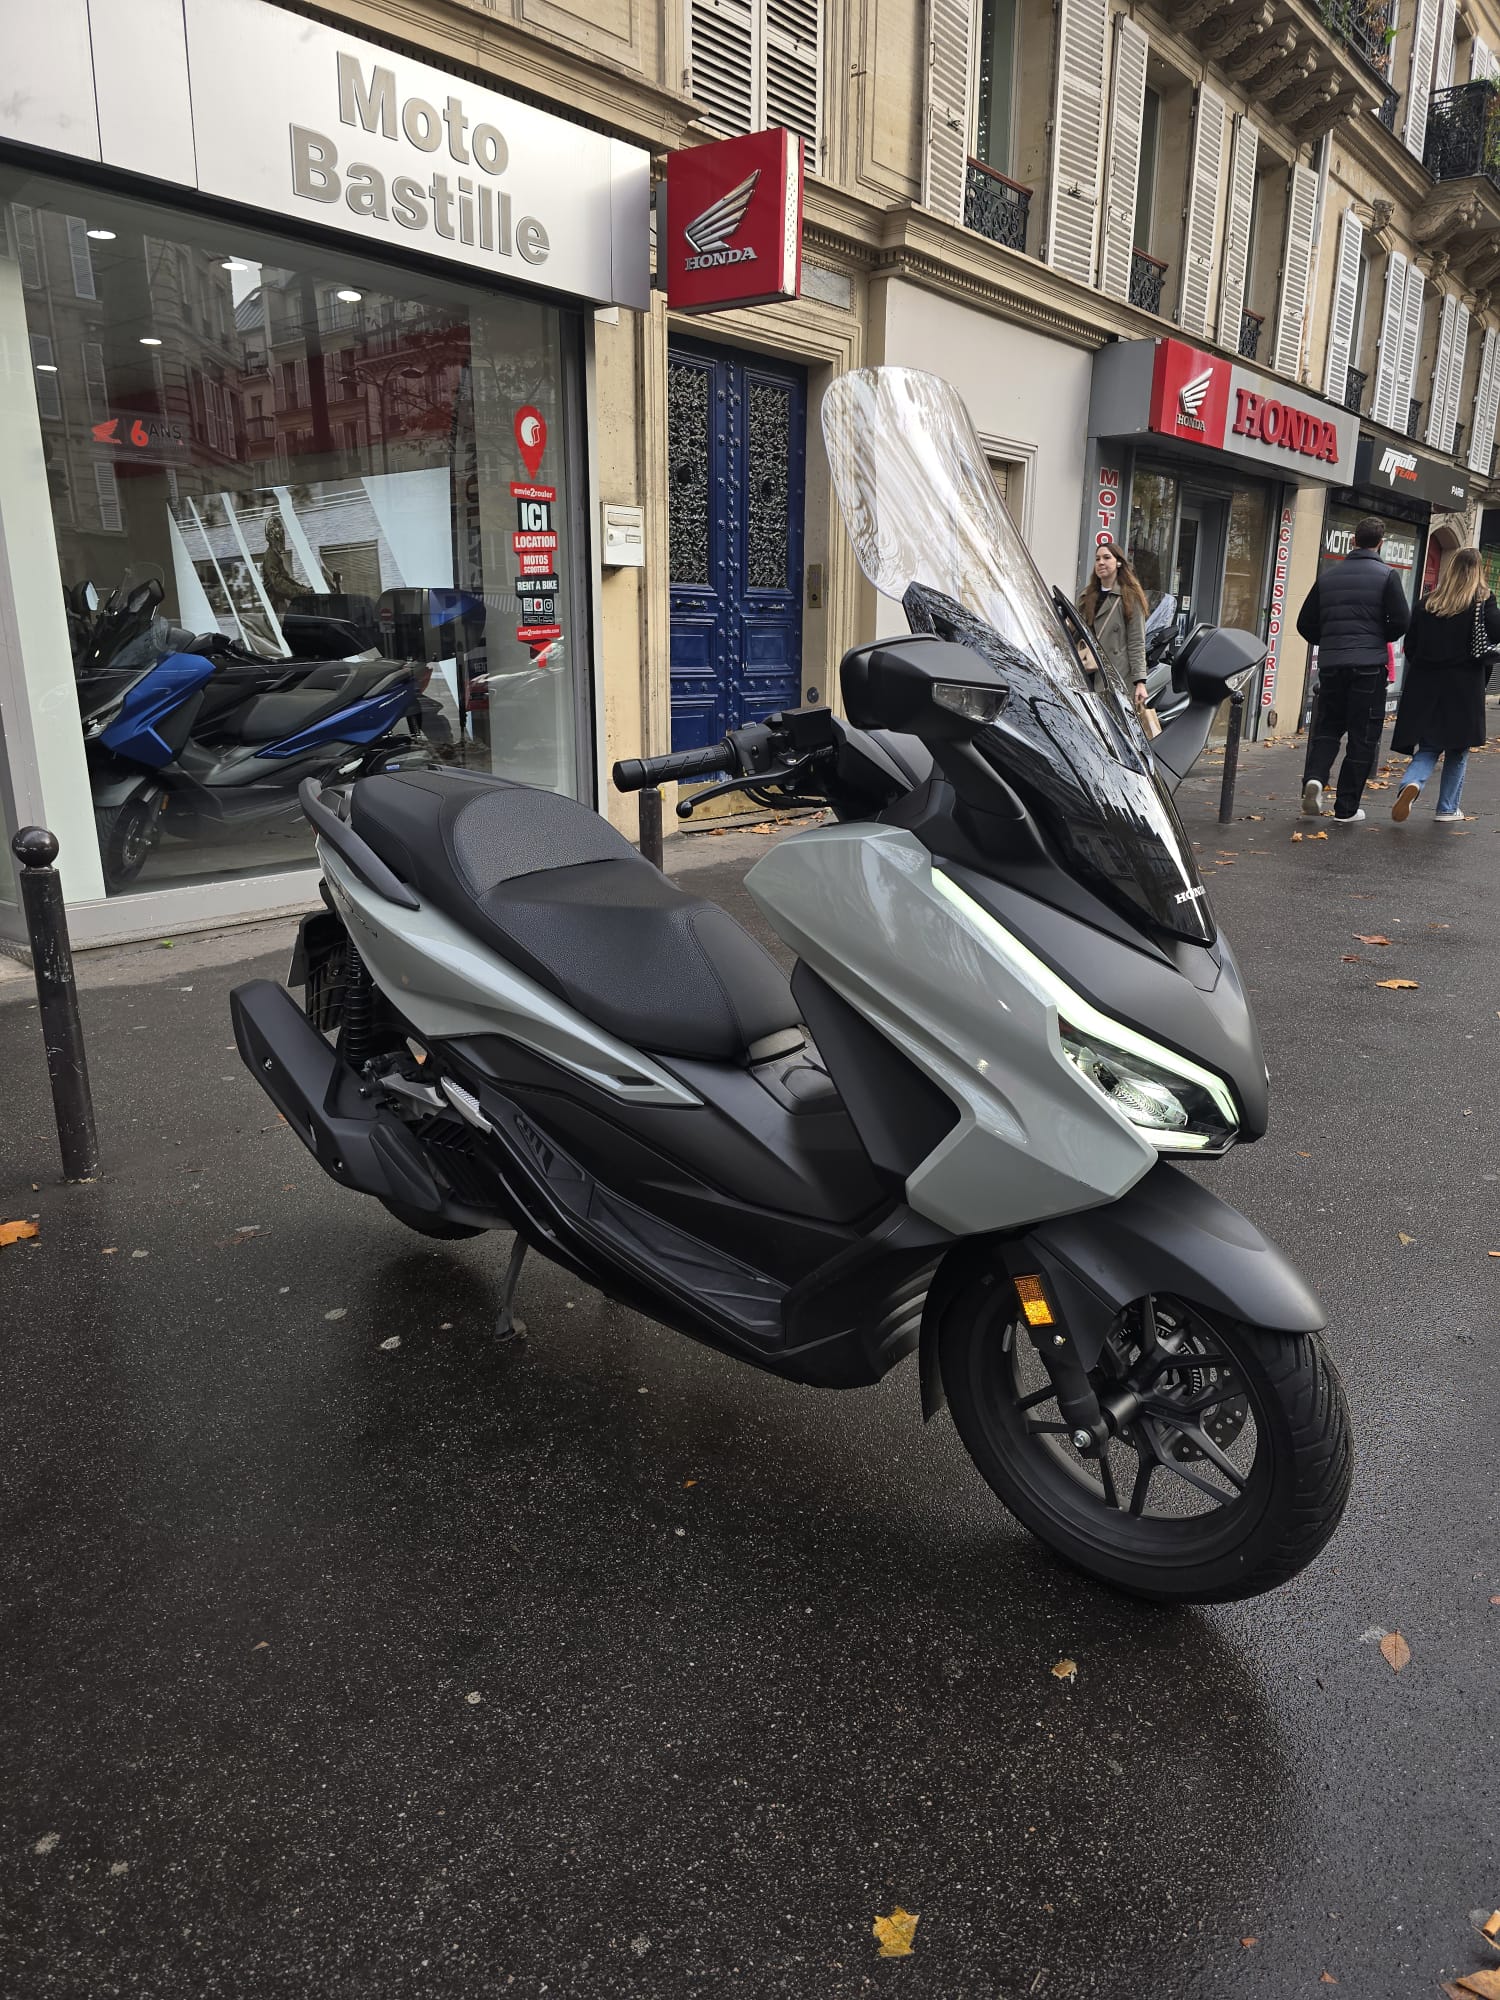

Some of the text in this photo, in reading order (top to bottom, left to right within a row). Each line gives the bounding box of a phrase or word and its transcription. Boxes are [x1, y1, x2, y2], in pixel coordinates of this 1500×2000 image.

[337, 50, 509, 176] Moto
[289, 122, 550, 266] Bastille
[685, 246, 758, 271] HONDA
[131, 420, 182, 447] 6 ANS
[1176, 413, 1206, 432] HONDA
[1233, 387, 1339, 464] HONDA
[521, 502, 548, 531] ICI
[1096, 467, 1119, 547] MOTO
[515, 535, 556, 549] LOCATION
[523, 554, 549, 565] MOTOS
[523, 565, 549, 574] SCOOTERS
[517, 580, 557, 591] RENT A BIKE
[1262, 509, 1292, 706] ACCESSOIRES
[1174, 885, 1206, 905] HON
